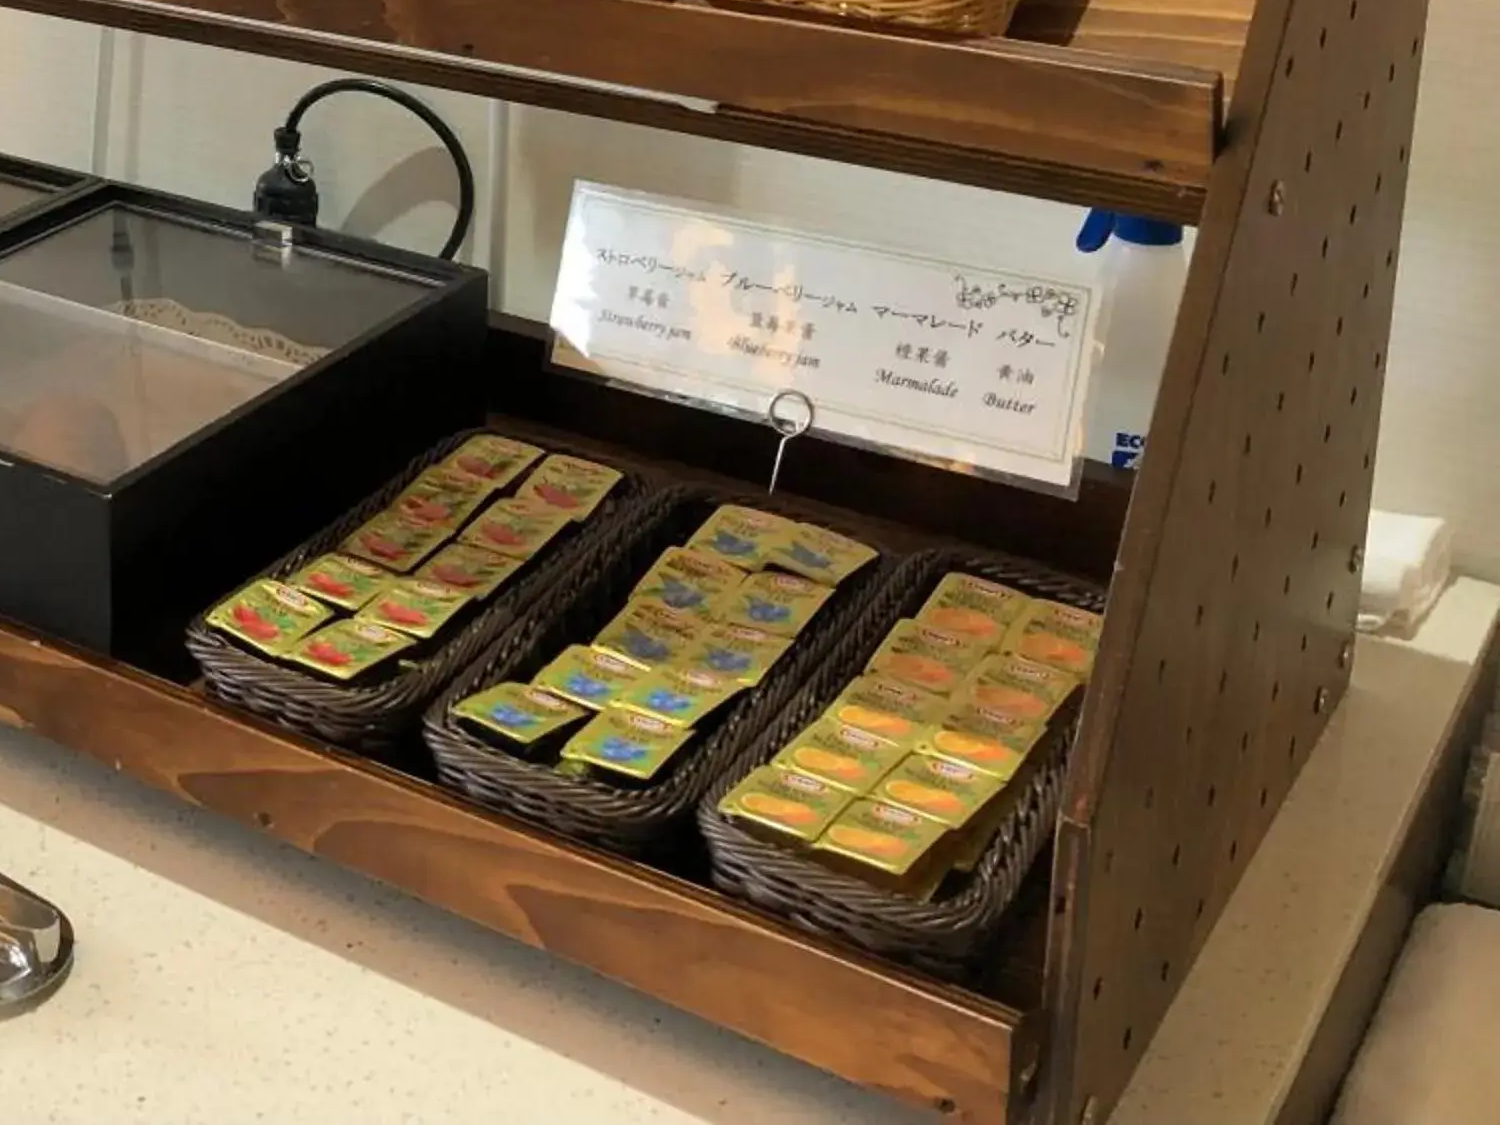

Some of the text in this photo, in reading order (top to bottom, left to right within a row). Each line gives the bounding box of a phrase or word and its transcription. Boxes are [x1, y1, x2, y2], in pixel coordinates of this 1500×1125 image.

[870, 304, 984, 338] マーマレード
[994, 328, 1056, 348] バター
